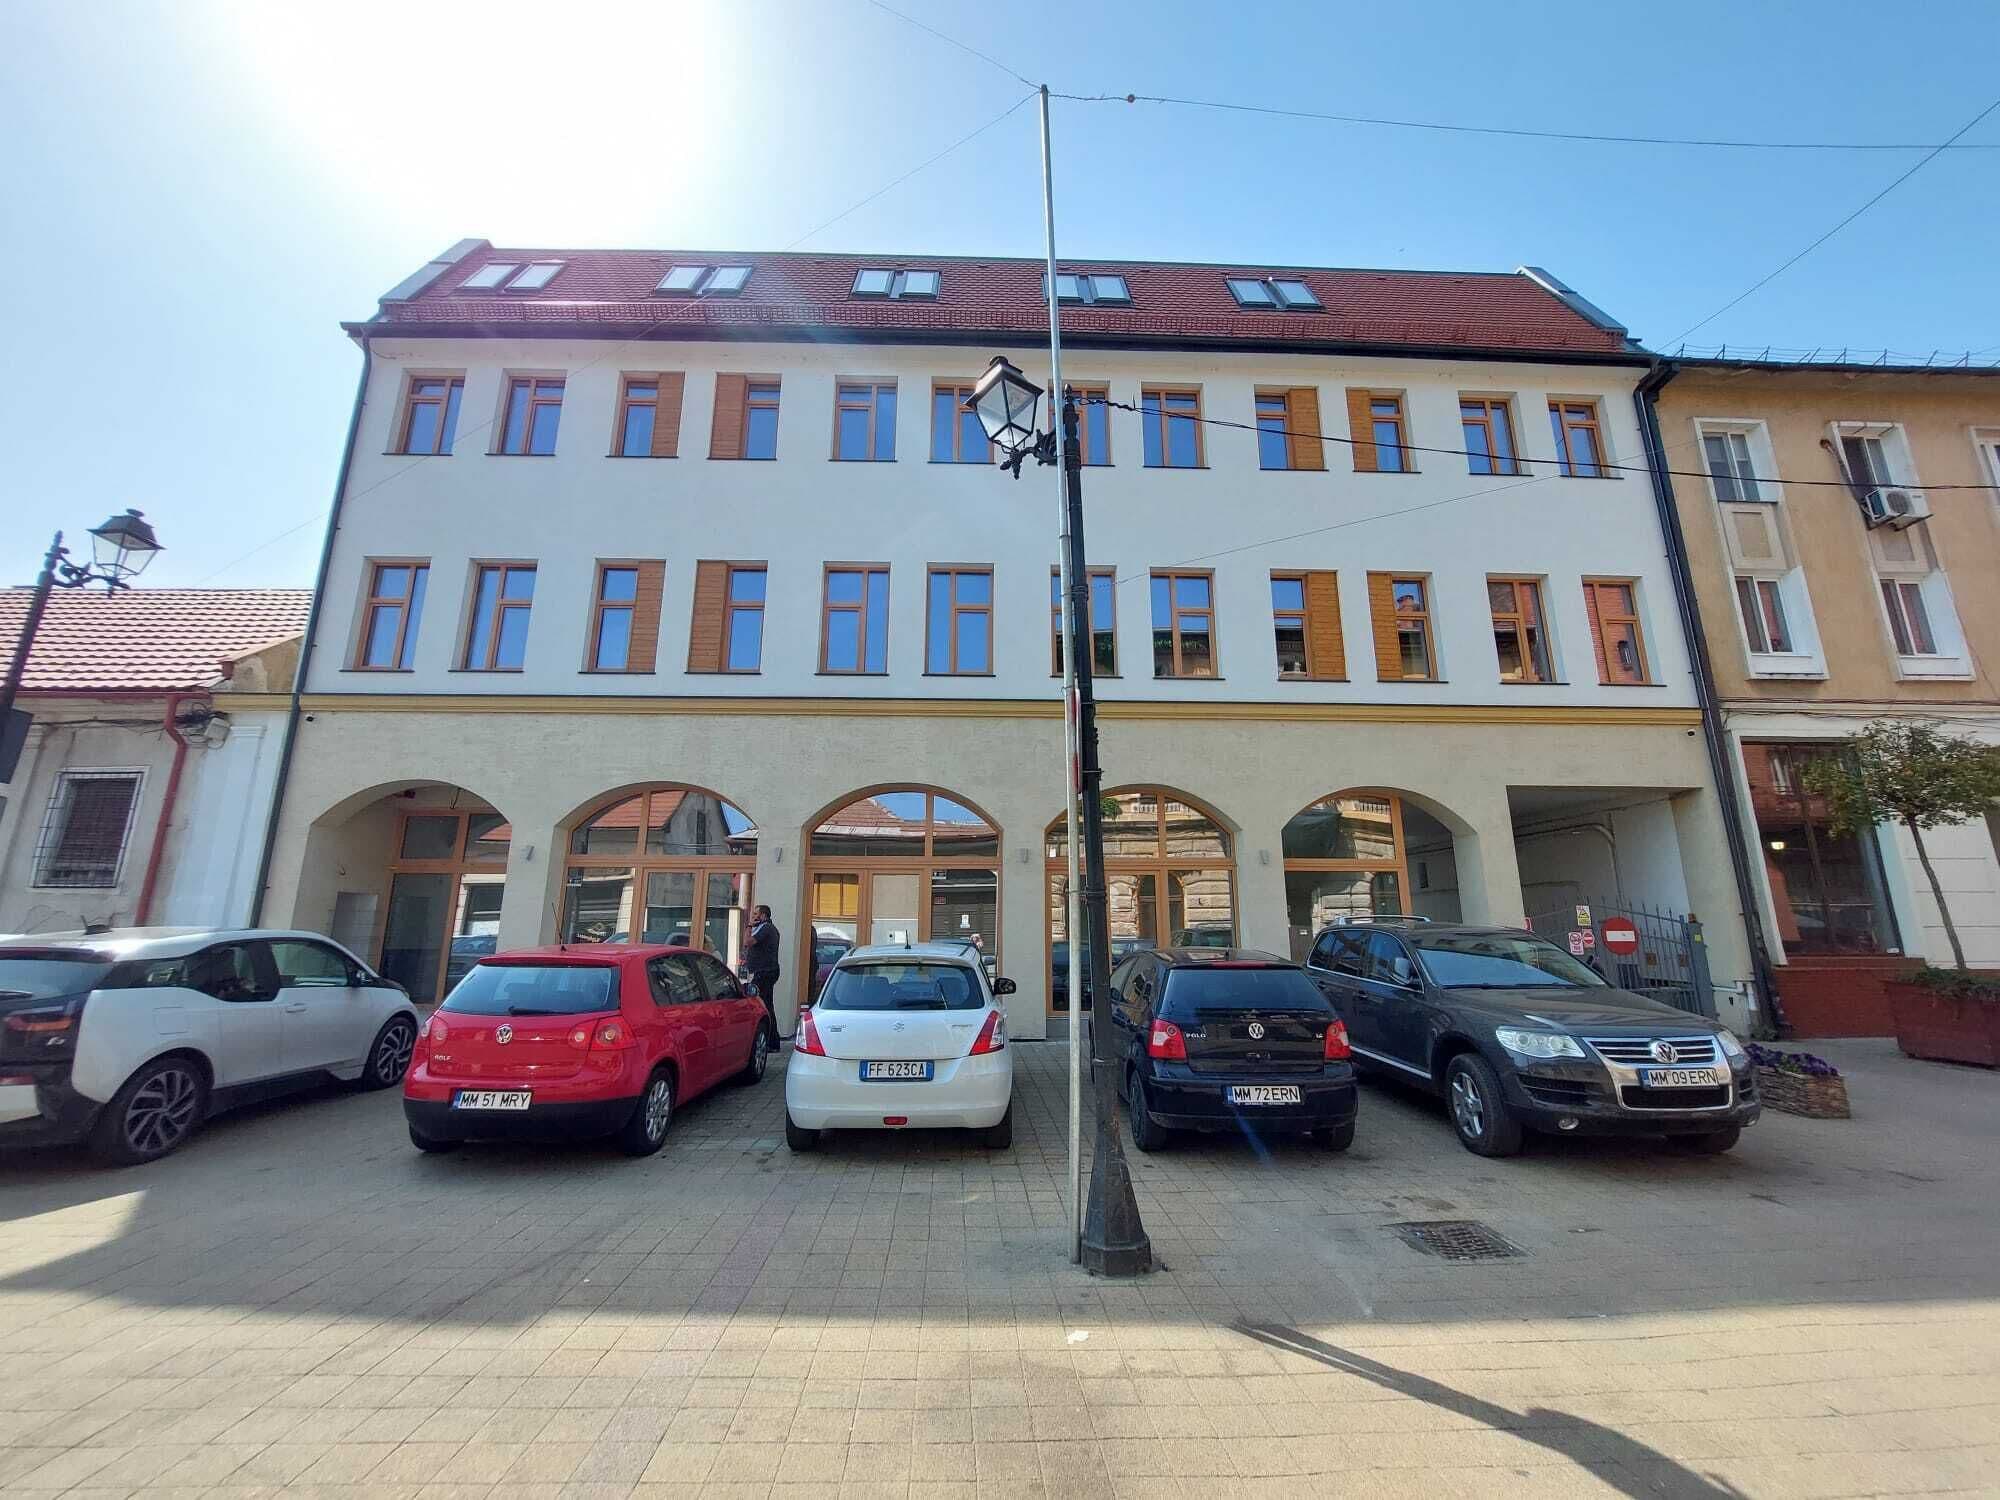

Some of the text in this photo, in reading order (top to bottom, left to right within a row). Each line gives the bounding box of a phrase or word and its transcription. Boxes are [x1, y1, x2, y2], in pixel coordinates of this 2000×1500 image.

[869, 1063, 925, 1077] FF 623CA
[1649, 1071, 1669, 1085] MM
[460, 1093, 530, 1107] MM 51 MRY
[1233, 1087, 1252, 1101] MM
